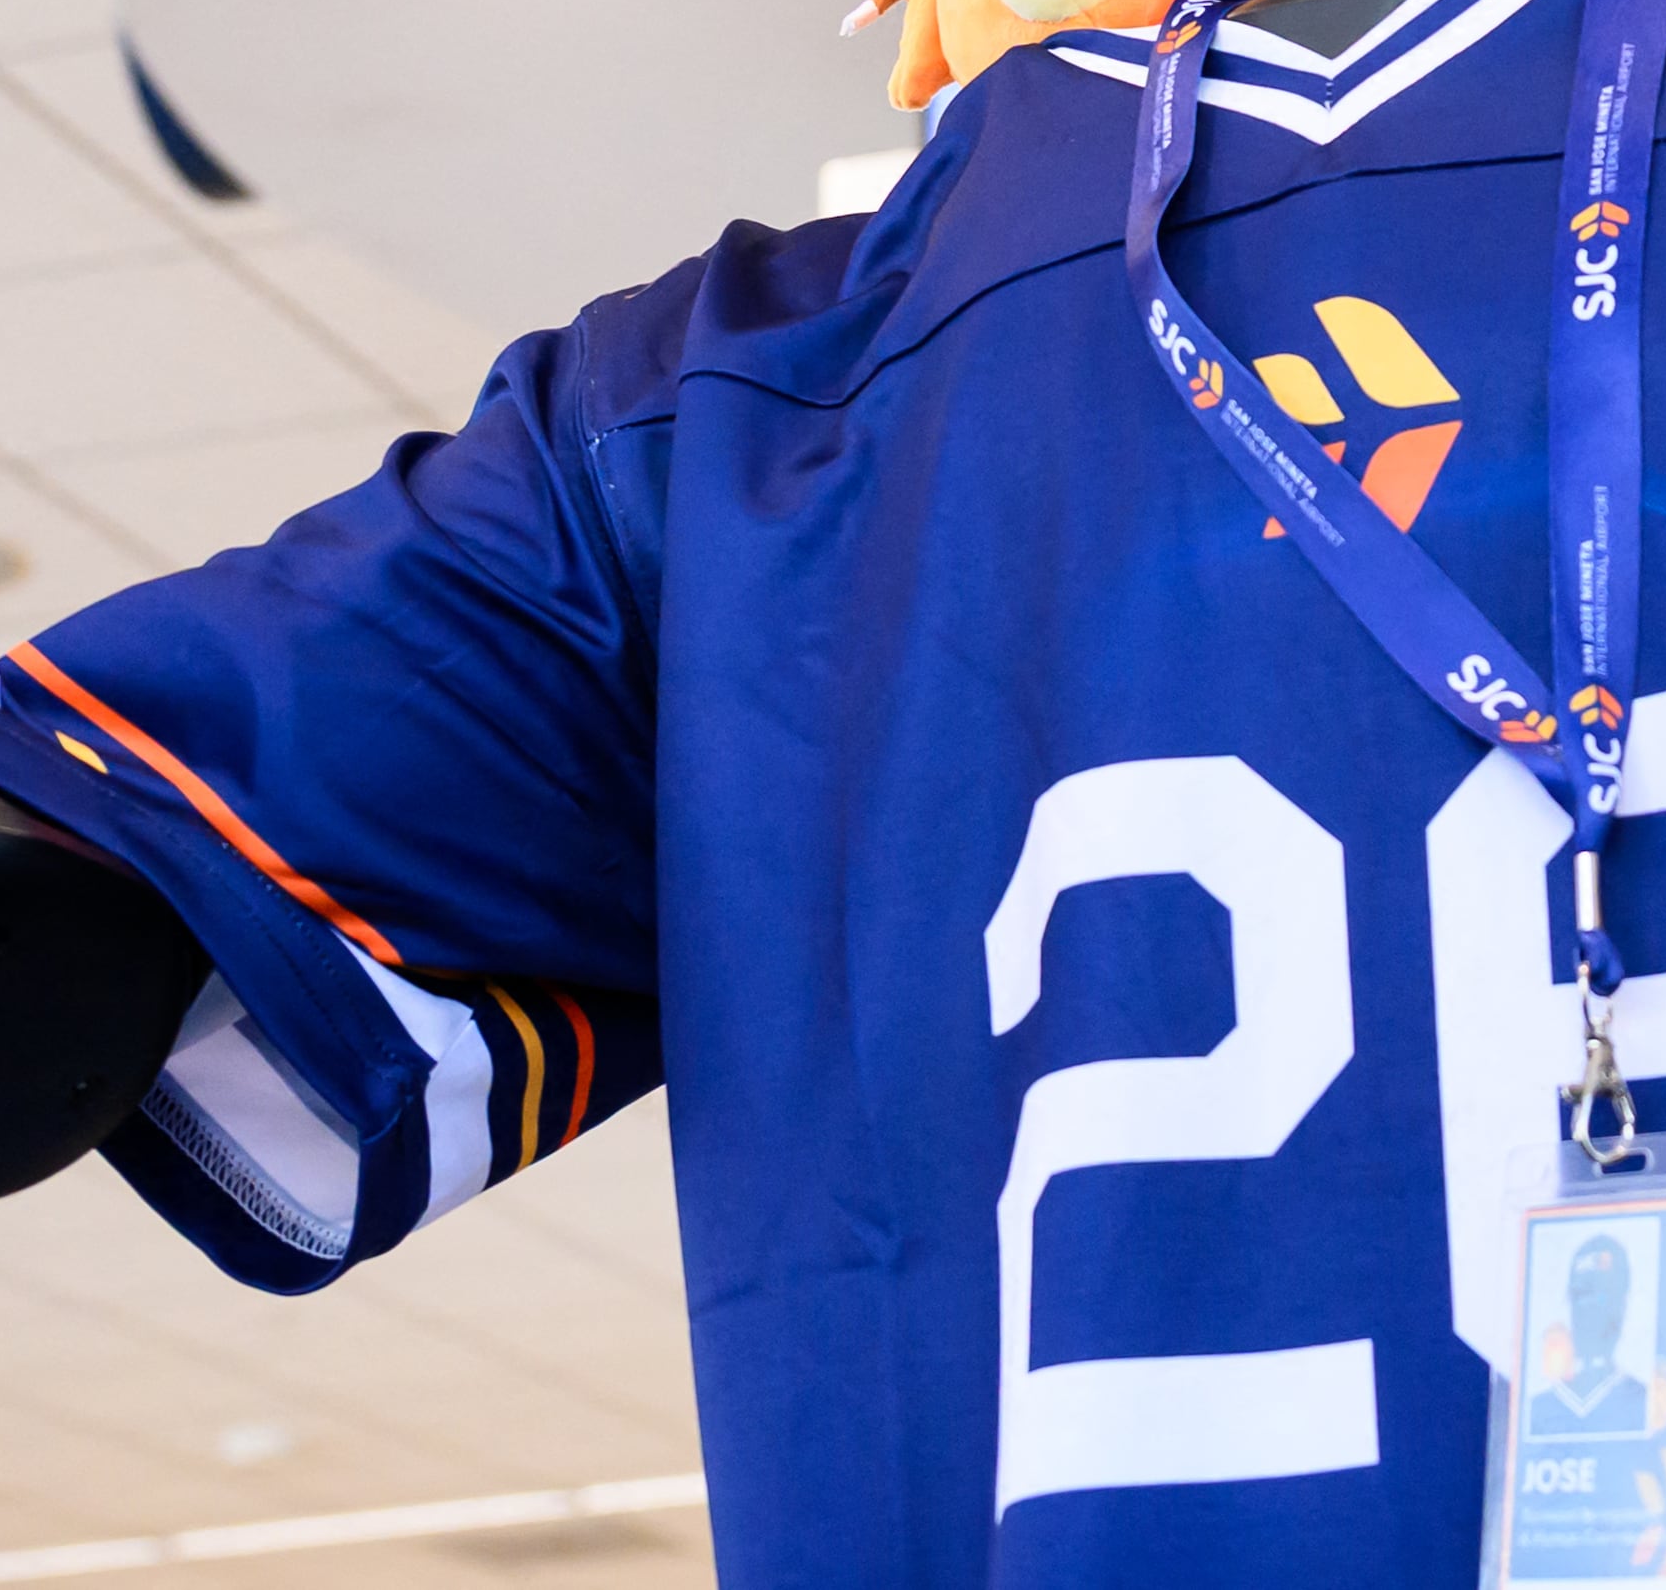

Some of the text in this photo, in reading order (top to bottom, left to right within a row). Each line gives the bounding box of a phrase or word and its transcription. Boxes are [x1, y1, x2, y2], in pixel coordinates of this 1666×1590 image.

[1588, 85, 1614, 196] SAN JOSE MINETA
[1571, 244, 1619, 321] SJC
[1148, 298, 1197, 376] SJC
[1225, 397, 1320, 500] SAN JOSE MINETA
[1579, 540, 1594, 602] MINETA
[1580, 604, 1594, 642] JOSE
[1446, 654, 1528, 721] SJC
[1584, 732, 1622, 814] SJC
[1521, 1457, 1598, 1494] JOSE
